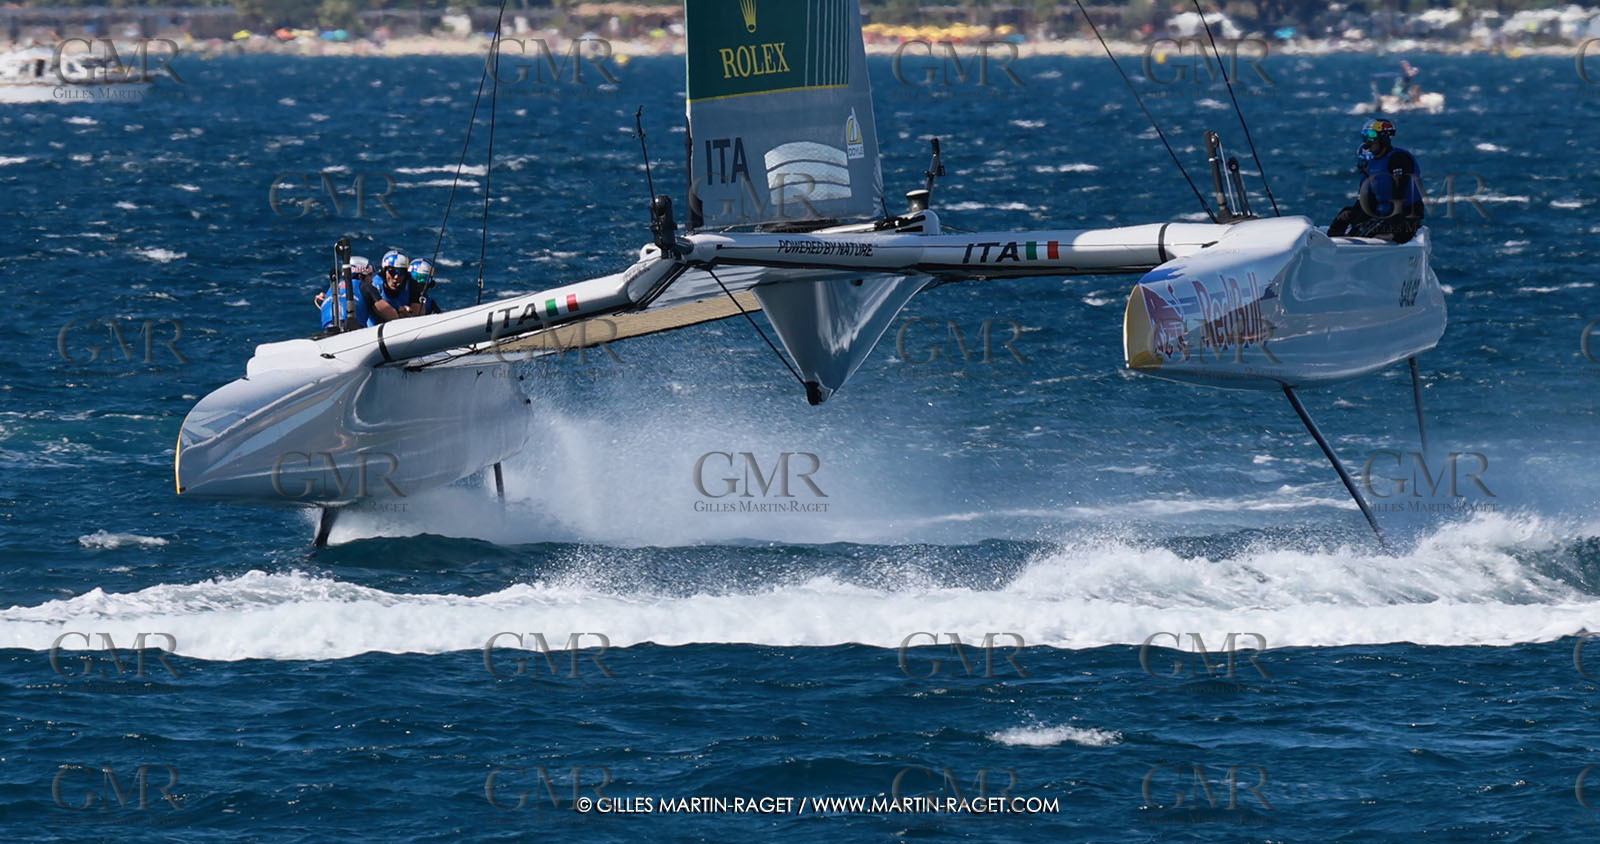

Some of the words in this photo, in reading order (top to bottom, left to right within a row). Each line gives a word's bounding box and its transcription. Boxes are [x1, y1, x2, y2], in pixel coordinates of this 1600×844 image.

[719, 42, 790, 79] ROLEX
[705, 137, 751, 185] ITA
[777, 240, 821, 254] POWERED
[822, 240, 838, 256] BY
[962, 241, 1020, 264] ITA
[485, 302, 541, 333] ITA
